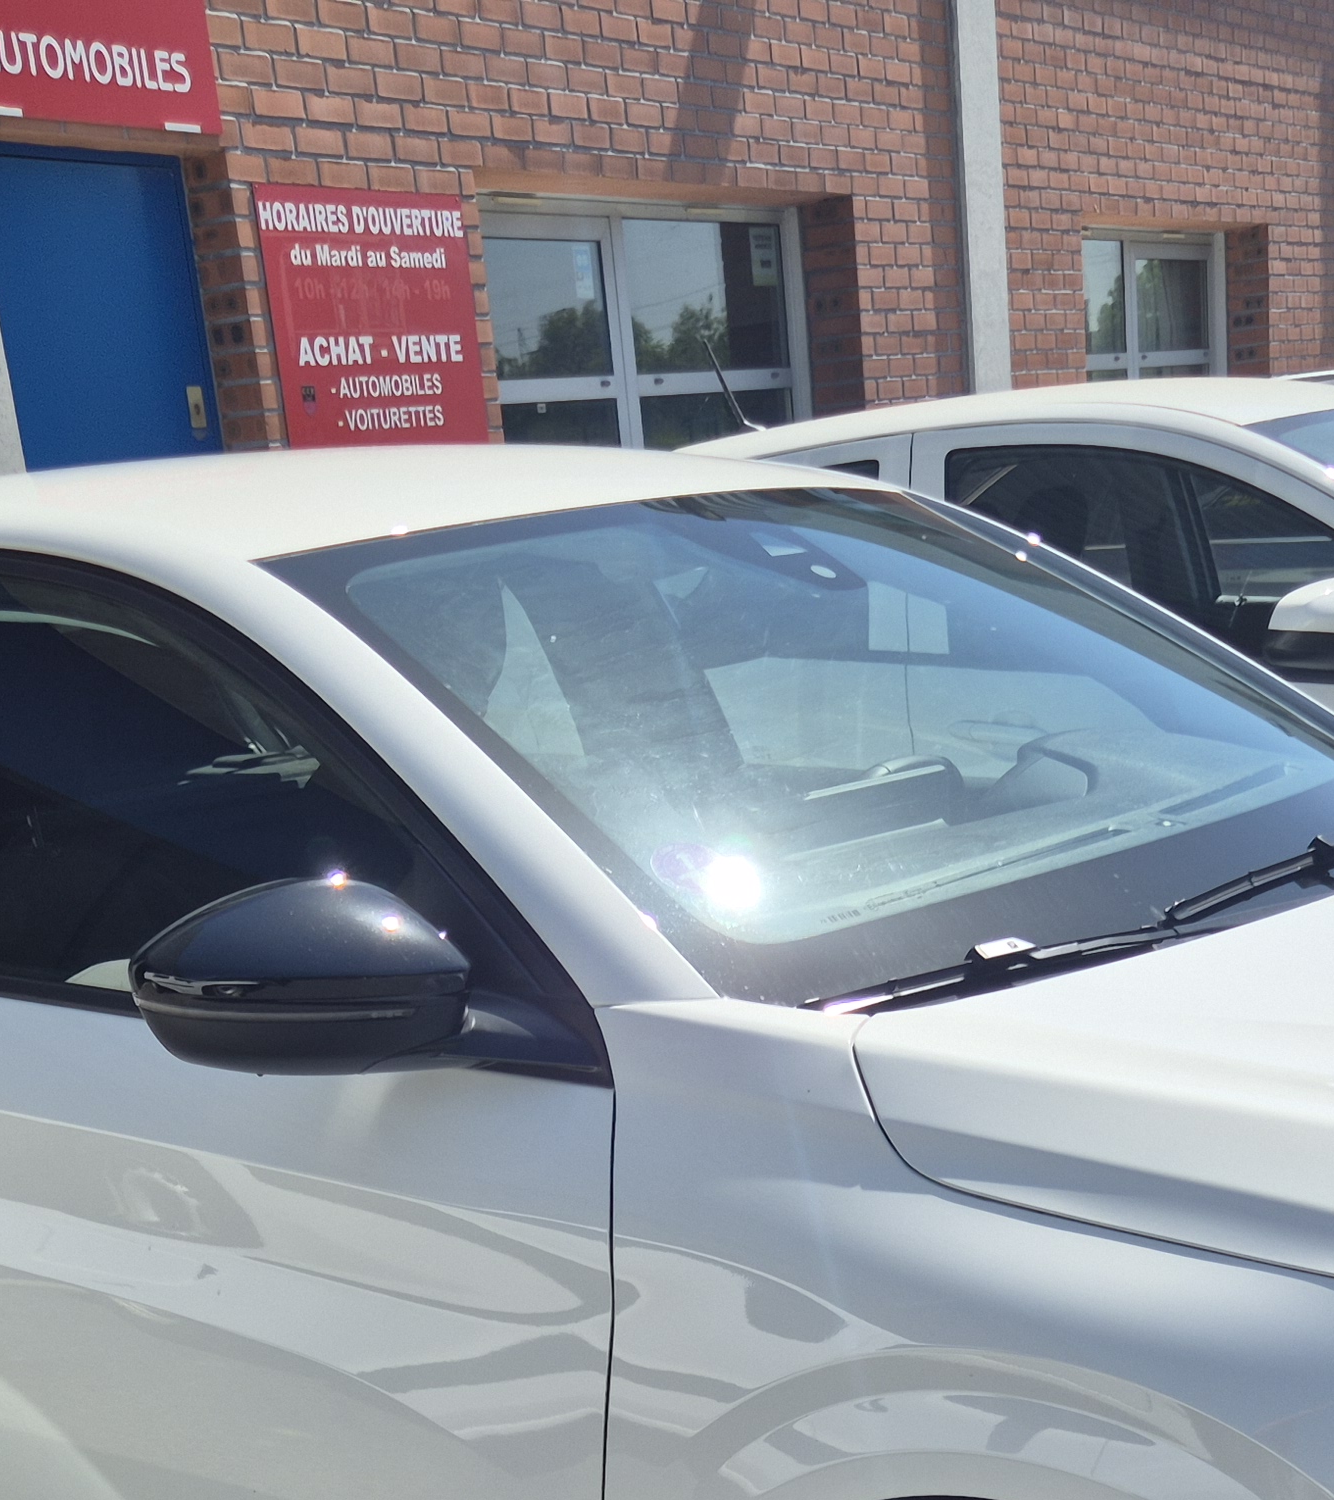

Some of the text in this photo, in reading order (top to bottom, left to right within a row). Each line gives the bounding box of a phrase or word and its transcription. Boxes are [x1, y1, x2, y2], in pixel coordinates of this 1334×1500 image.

[258, 201, 464, 238] HORAIRES D'OUVERTURE
[290, 243, 447, 269] du Mardi au Samedi
[299, 336, 373, 367] ACHAT
[391, 334, 463, 363] VENTE
[339, 373, 443, 399] AUTOMOBILES
[345, 405, 445, 431] VOITURETTES
